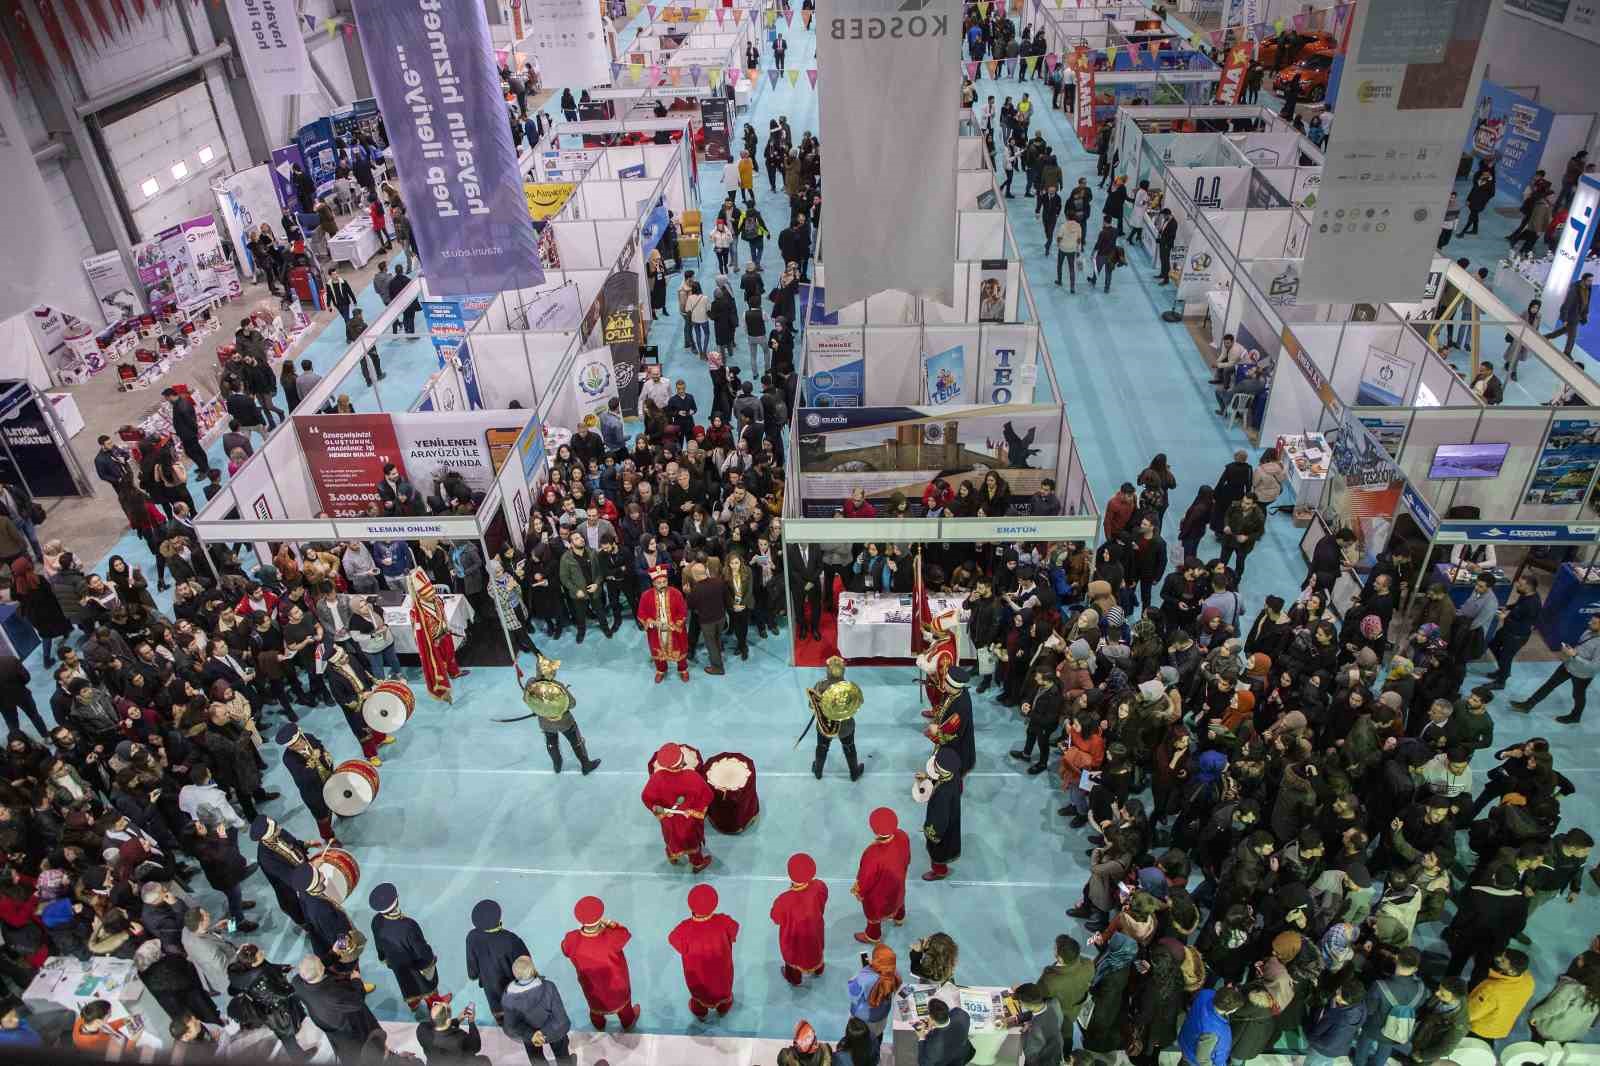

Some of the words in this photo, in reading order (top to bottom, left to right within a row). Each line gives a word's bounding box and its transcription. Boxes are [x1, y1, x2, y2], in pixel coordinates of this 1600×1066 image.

[414, 437, 477, 448] YENİLENEN
[410, 448, 460, 458] ARAYÜZÜ
[463, 448, 480, 457] İLE
